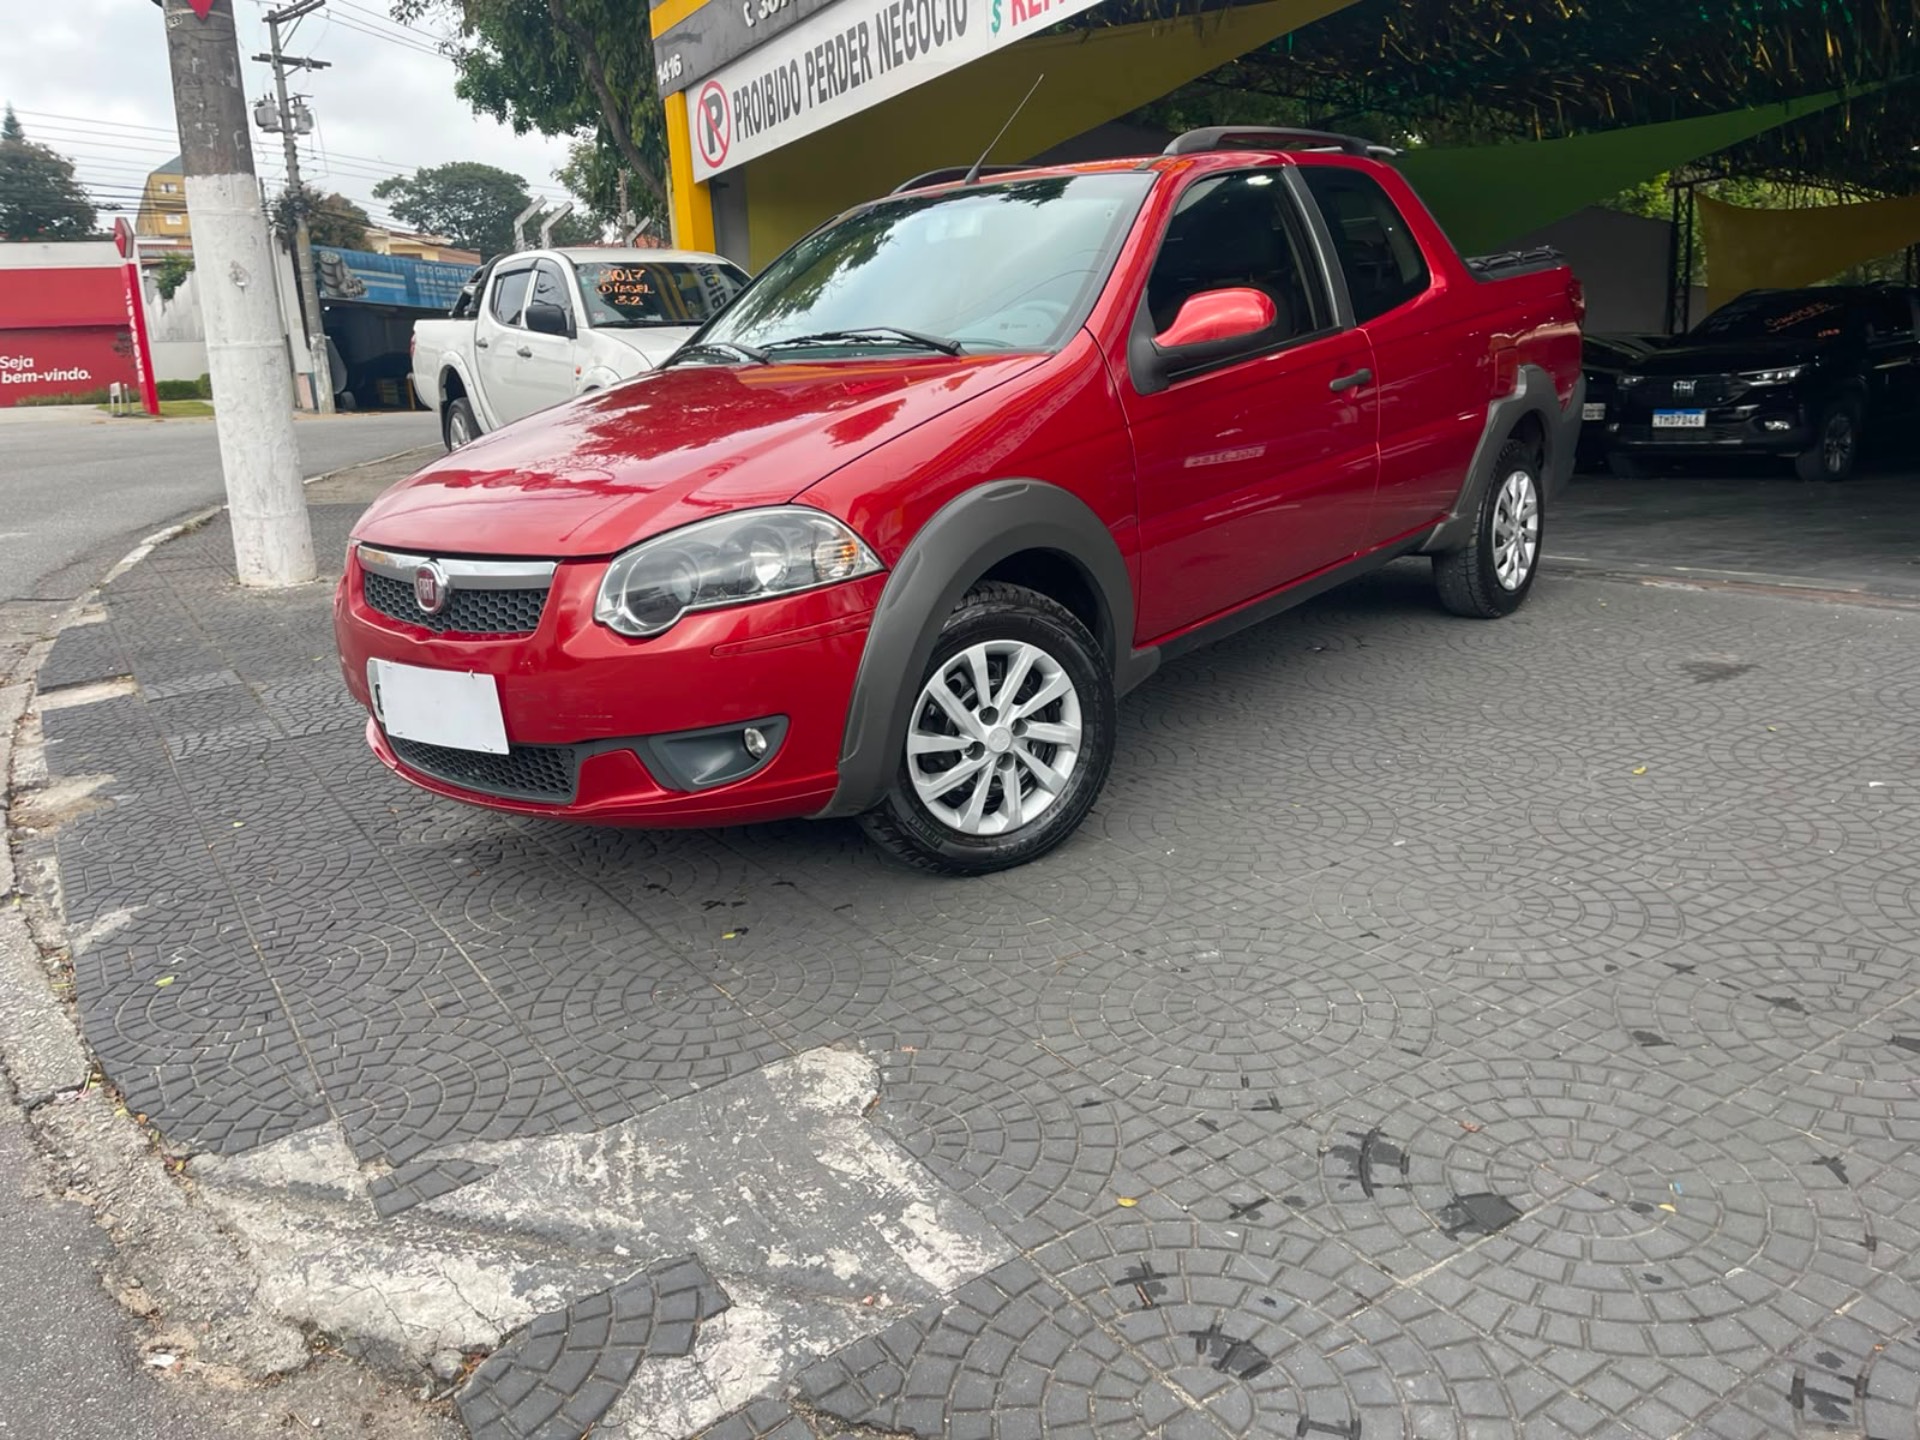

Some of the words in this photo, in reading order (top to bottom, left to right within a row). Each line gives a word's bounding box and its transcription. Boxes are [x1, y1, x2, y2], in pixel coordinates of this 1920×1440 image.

[657, 53, 682, 85] 1416
[732, 58, 801, 143] PROIBIDO
[804, 20, 873, 109] PERDER
[0, 355, 34, 371] Seja
[1, 367, 92, 384] bem-vindo.
